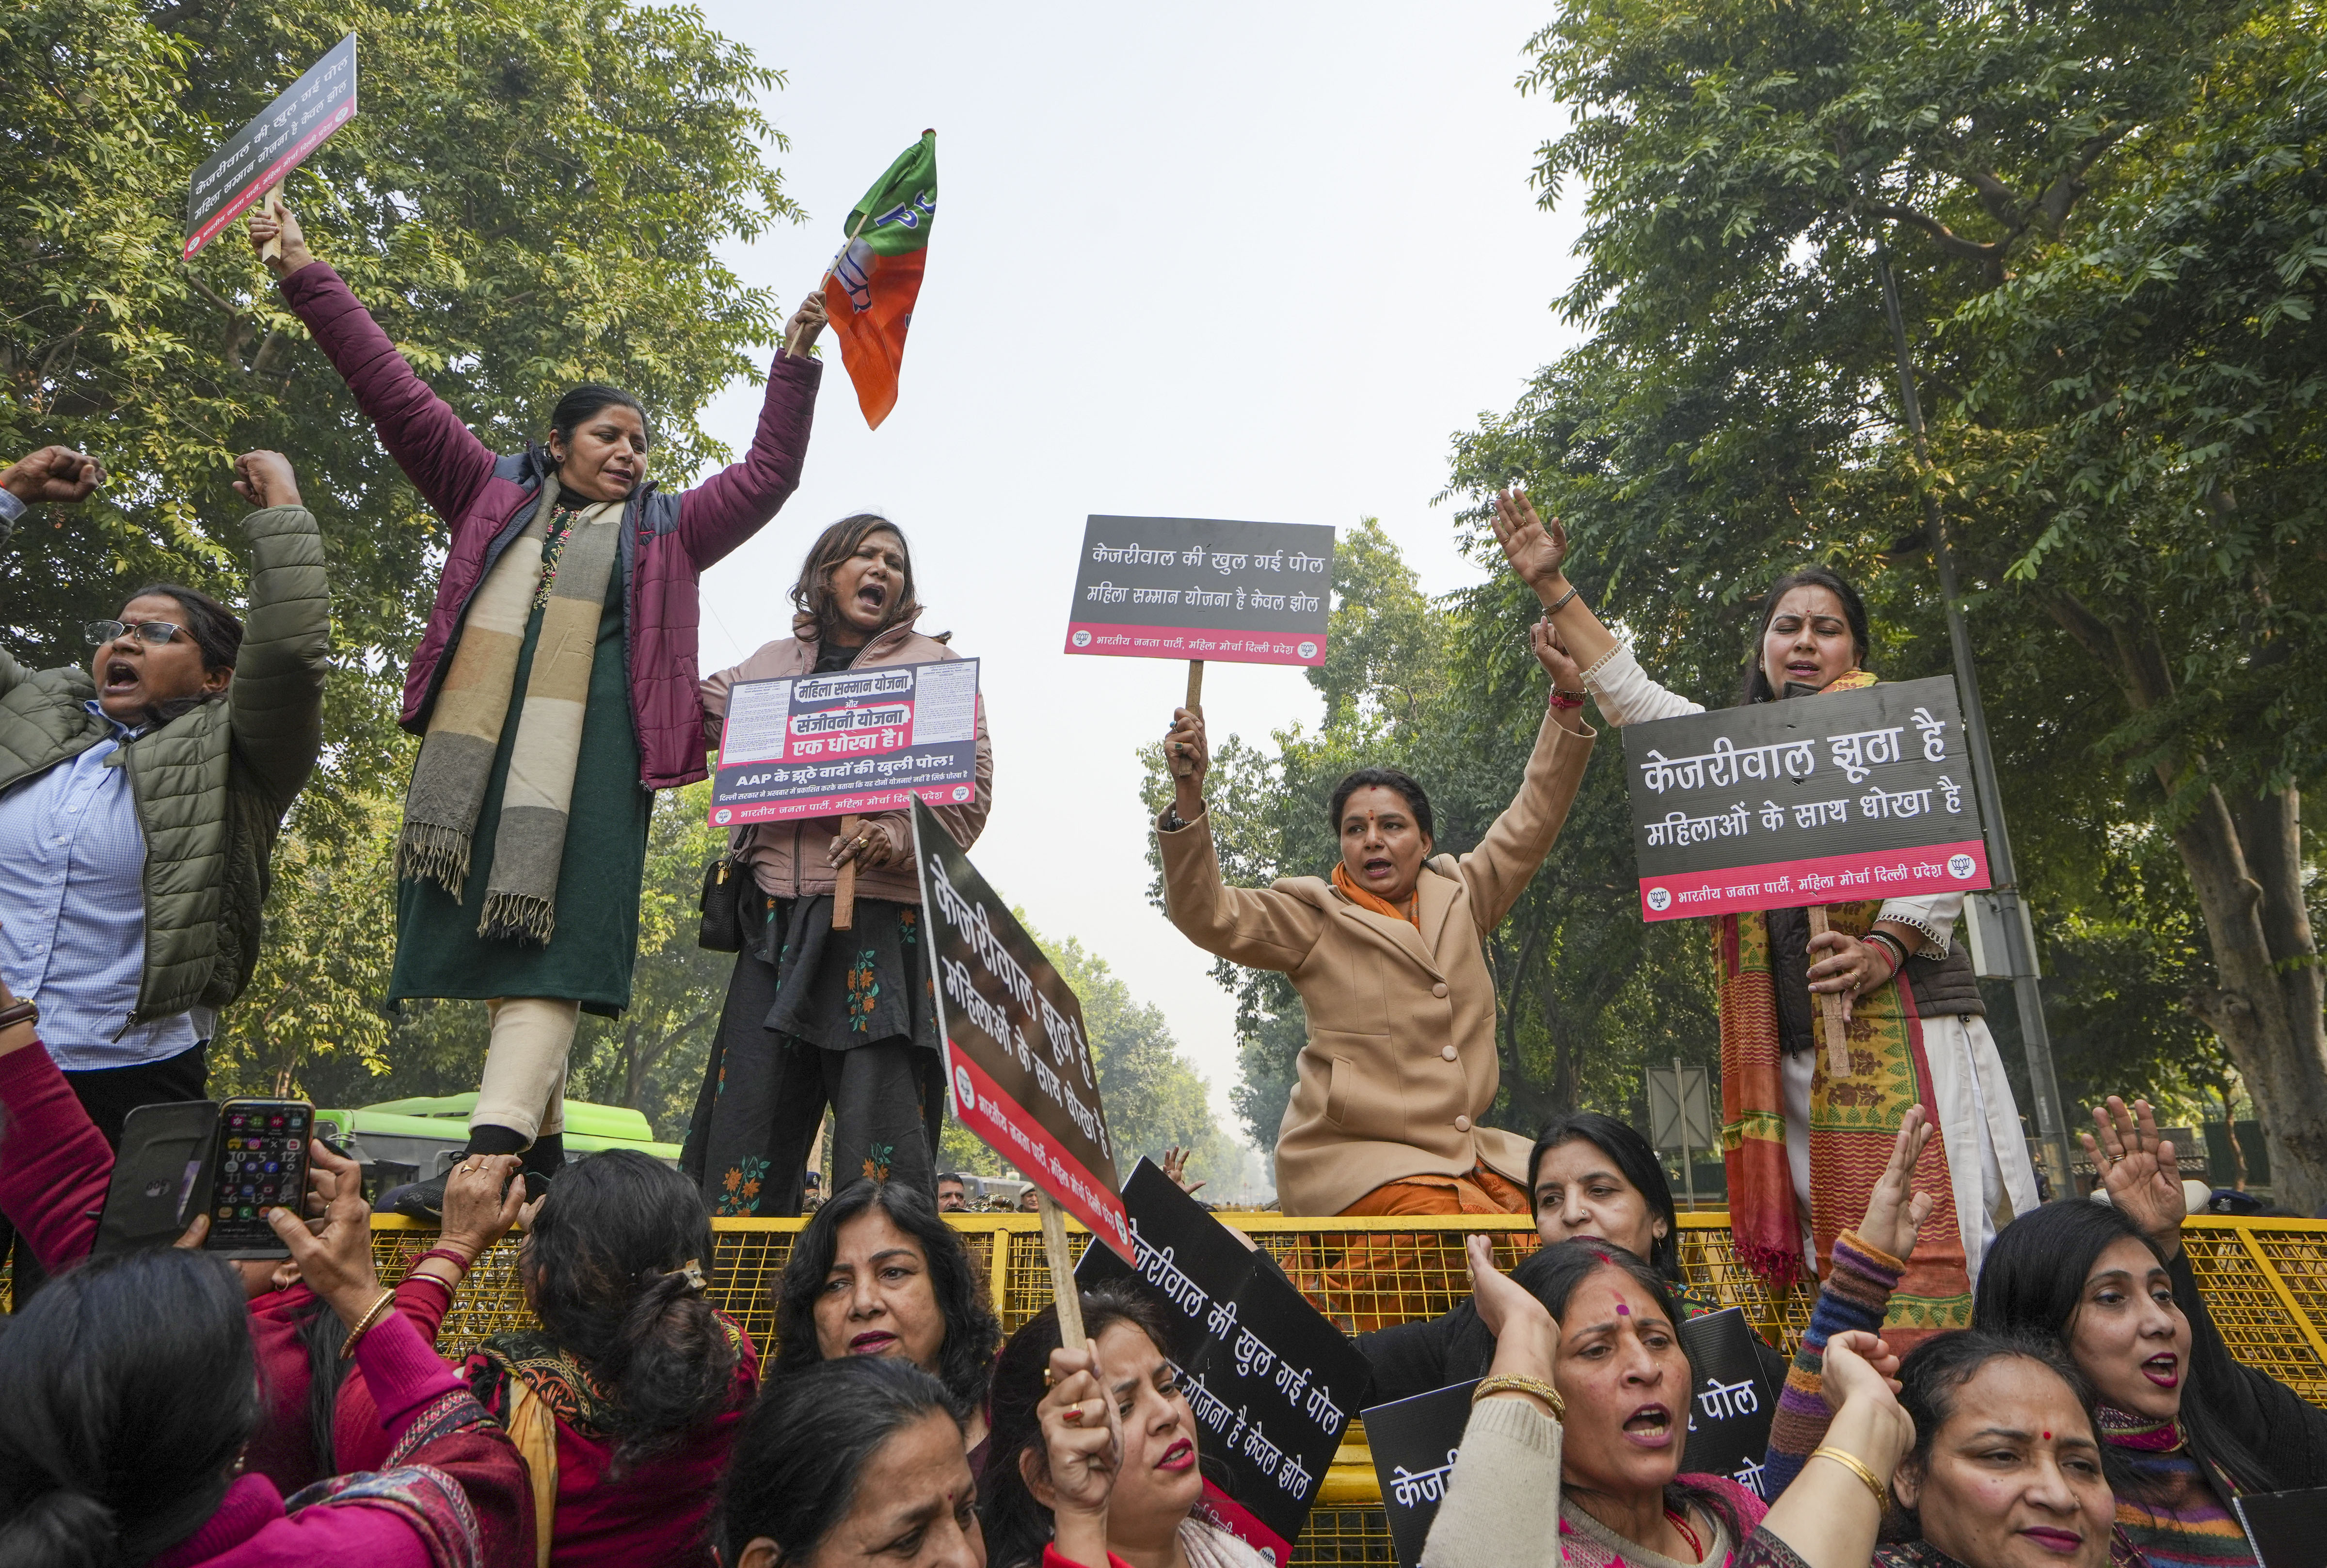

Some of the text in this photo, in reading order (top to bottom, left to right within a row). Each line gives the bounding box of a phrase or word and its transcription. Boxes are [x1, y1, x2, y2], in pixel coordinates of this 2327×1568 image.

[195, 55, 349, 195] केजरीवाल की खुल गई पोल
[194, 79, 347, 220] महिला सम्मान योजना है केवल झोल
[1092, 542, 1326, 575] केजरीवाल की खुल गई पोल
[1087, 581, 1320, 612] महिला सम्मान योजना है केवल झोल
[1096, 634, 1295, 655] भारतीय जनता पार्टी, महिला मोर्चा दिल्ली प्रदेश
[798, 675, 909, 698] महिला सम्मान योजना
[845, 700, 859, 708] और
[797, 709, 905, 733] संजीवनी योजना
[792, 728, 904, 756] एक धोखा है।
[1640, 707, 1946, 794] केजरीवाल झूठा है
[719, 792, 737, 802] दिल्ली
[738, 792, 760, 800] सरकार
[766, 789, 789, 797] अखबार
[789, 785, 797, 794] में
[797, 785, 821, 794] प्रकाशित
[820, 783, 837, 792] करके
[855, 780, 863, 788] कि
[874, 777, 889, 786] दोनों
[889, 775, 912, 785] योजनाएं
[946, 771, 962, 779] धोखा
[735, 754, 954, 787] AAP के झूठे वादों की खुली पोल!
[740, 806, 777, 818] भारतीय
[779, 805, 807, 814] जनता
[809, 800, 831, 811] पार्टी,
[835, 798, 864, 808] महिला
[866, 793, 891, 805] मोर्चा
[921, 790, 944, 801] प्रदेश
[1644, 775, 1961, 846] महिलाओं के साथ धोखा है
[1678, 861, 1943, 903] भारतीय जनता पार्टी, महिला मोर्चा दिल्ली प्रदेश
[929, 853, 1093, 1089] केजरीवाल झूठा है
[941, 955, 1109, 1159] महिलाओं के साथ धोखा है
[1208, 1301, 1237, 1340] की
[1235, 1327, 1276, 1376] खुल
[1275, 1360, 1312, 1406] गई
[1306, 1387, 1343, 1435] पोल
[1698, 1378, 1757, 1421] पोल
[1181, 1373, 1313, 1500] योजना है केवल झोल
